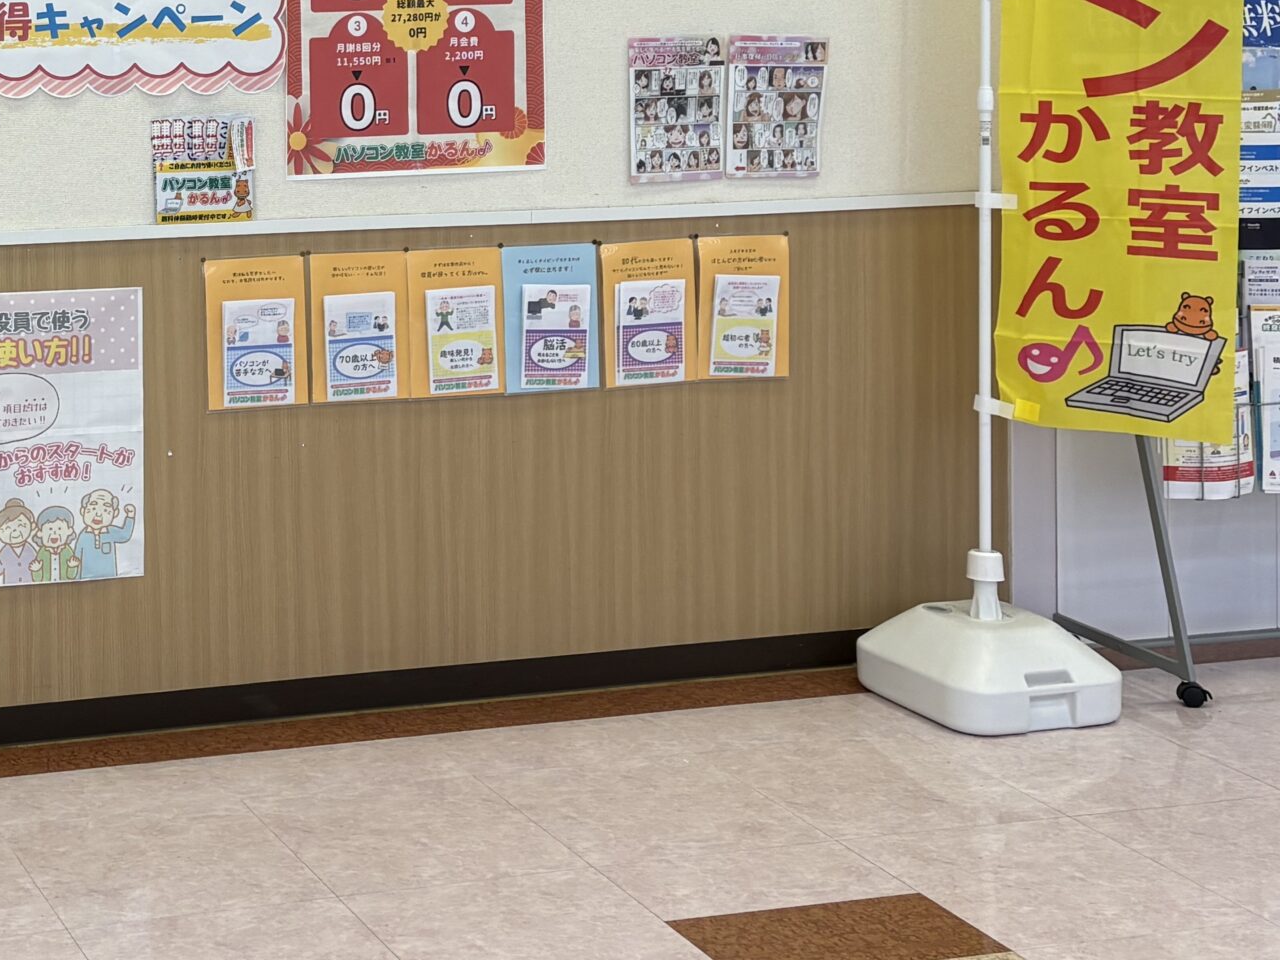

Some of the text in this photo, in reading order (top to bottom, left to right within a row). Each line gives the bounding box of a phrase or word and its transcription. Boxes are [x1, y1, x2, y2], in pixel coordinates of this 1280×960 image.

[391, 12, 441, 24] 27,280円が
[408, 27, 427, 39] 0円
[336, 42, 381, 53] 月謝8回分
[449, 37, 479, 47] 月会費
[336, 55, 381, 66] 11,550円
[444, 50, 484, 61] 2,200円
[162, 175, 232, 192] パソコン教室
[542, 338, 567, 351] 脳活
[338, 353, 377, 364] 70歳以上
[440, 347, 474, 359] 趣味発見!
[1172, 349, 1200, 367] try
[235, 359, 269, 368] パソコンが
[353, 363, 376, 371] の方へ
[235, 367, 272, 377] 苦手な方へ
[15, 464, 92, 488] おすすめ!
